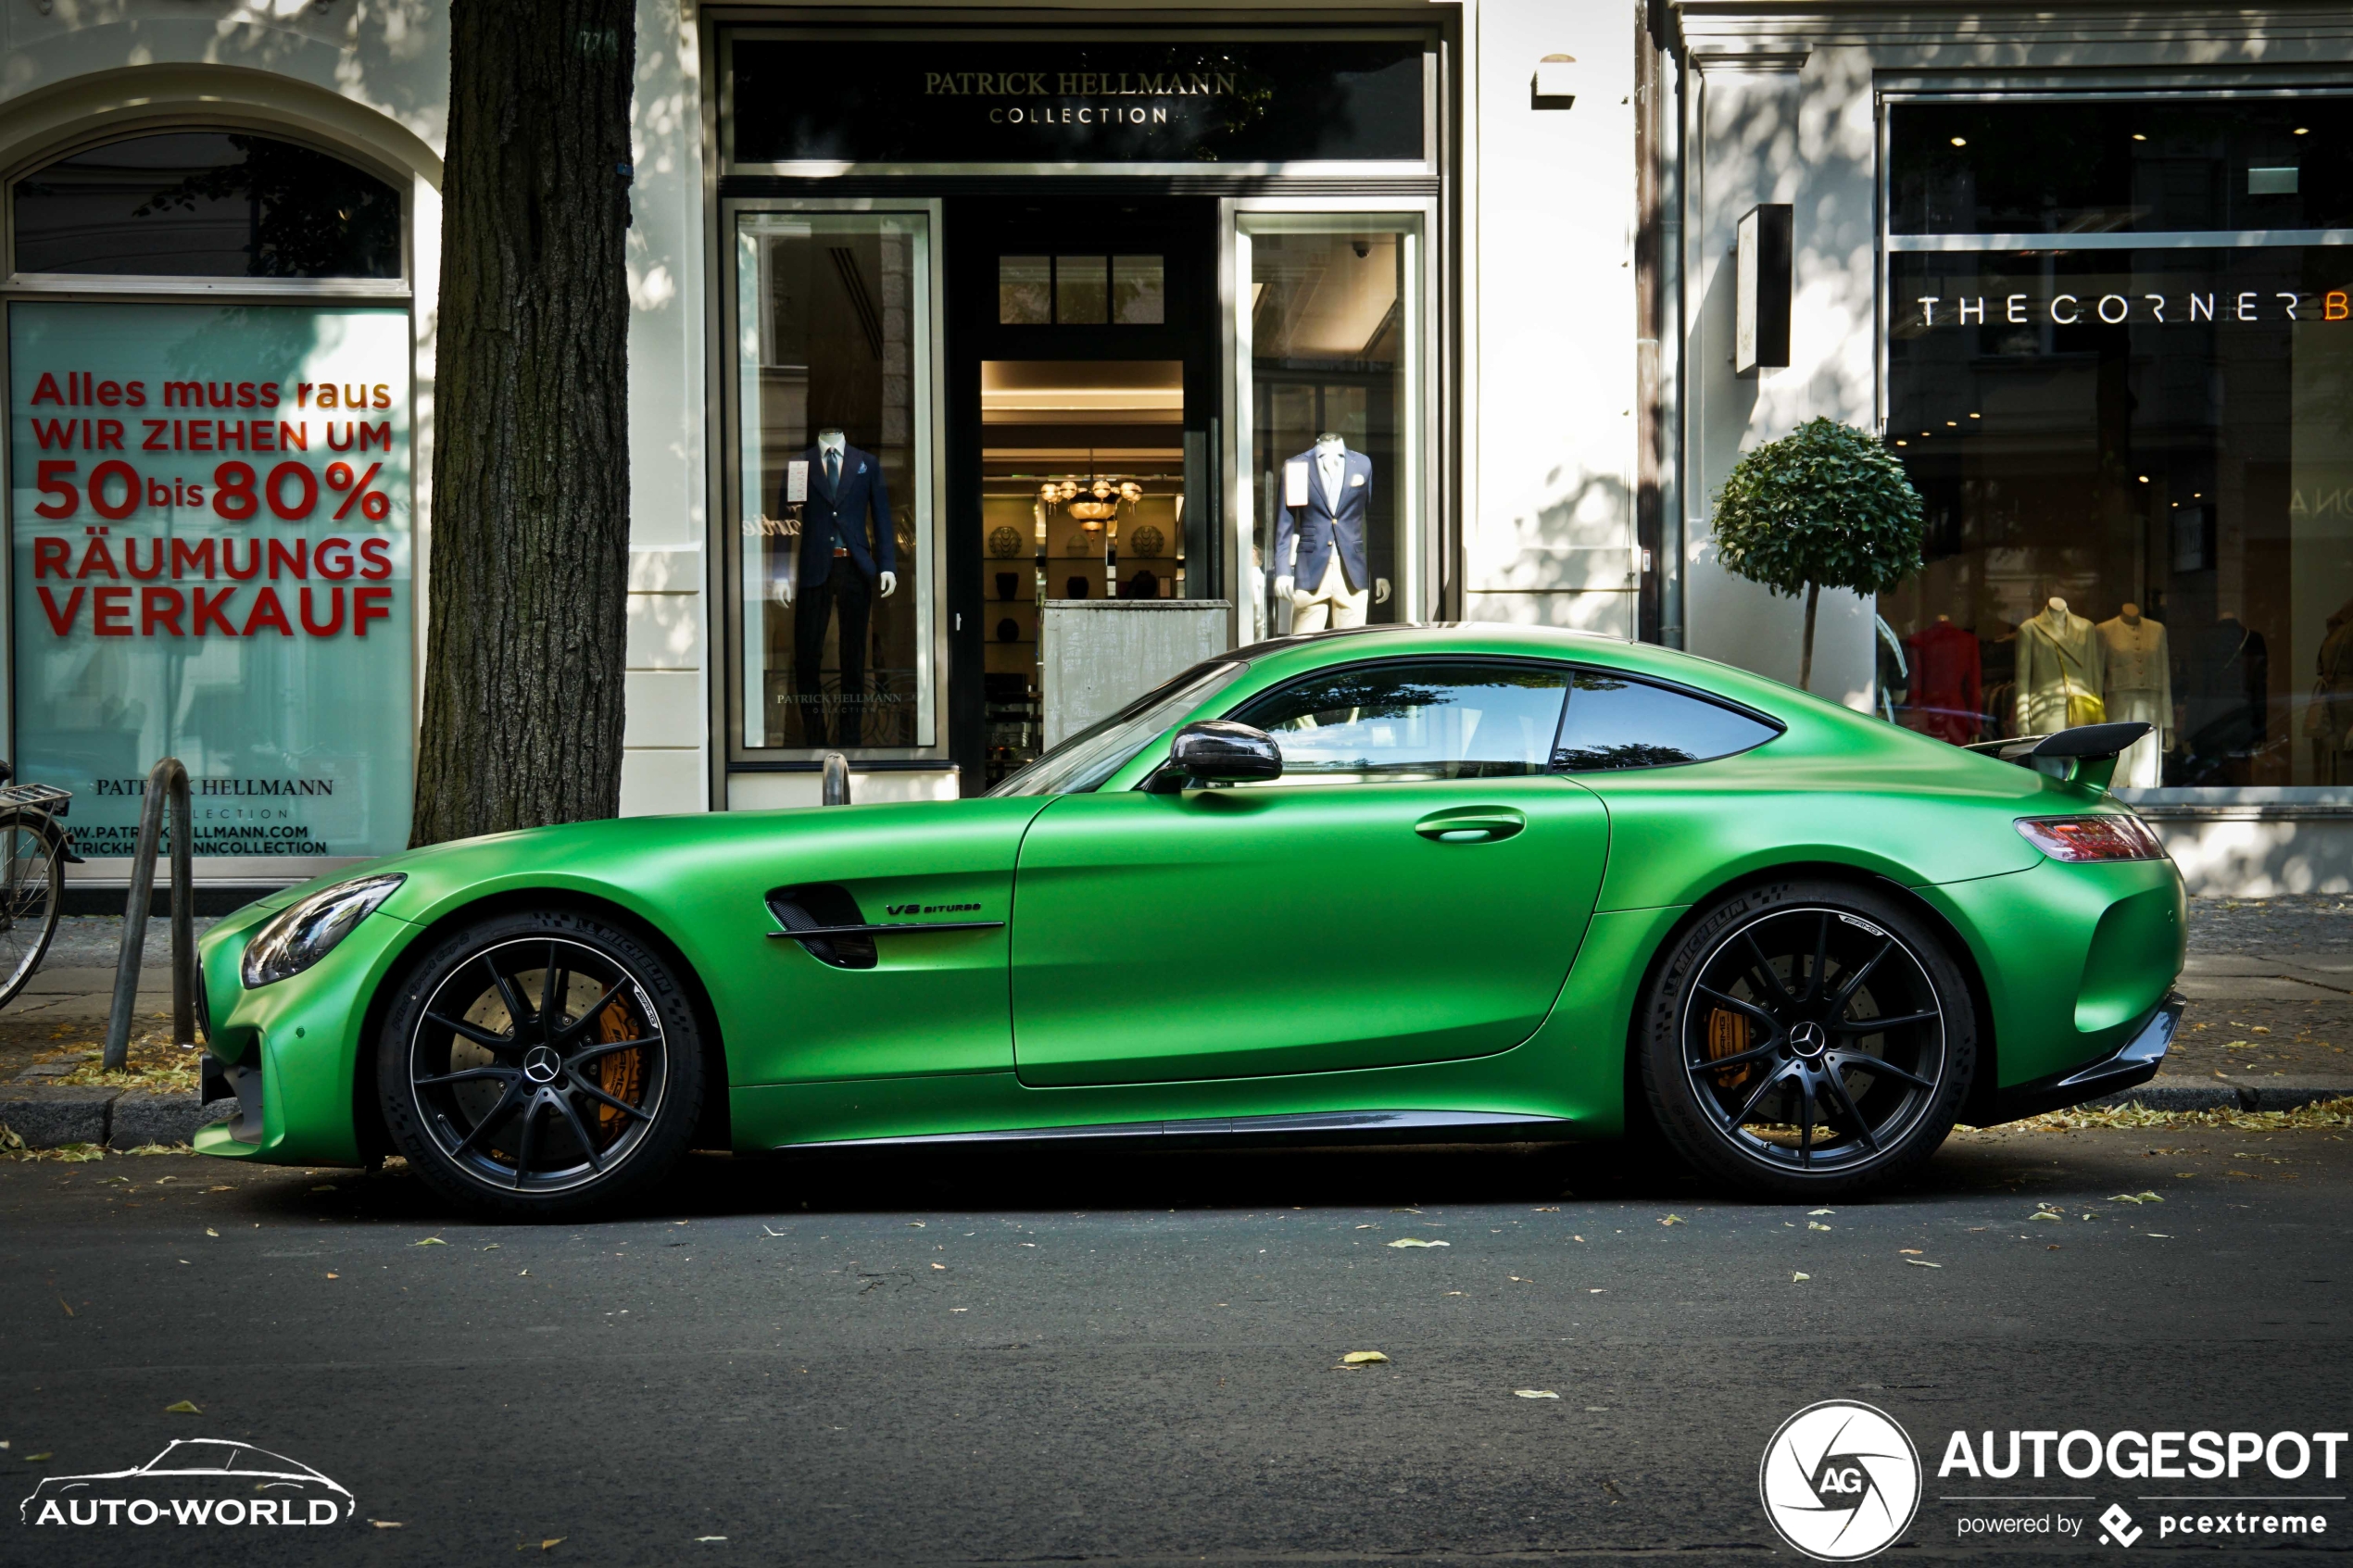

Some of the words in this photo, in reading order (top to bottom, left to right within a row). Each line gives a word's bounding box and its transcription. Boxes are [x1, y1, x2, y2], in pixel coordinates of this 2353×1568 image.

[925, 73, 1047, 94] PATRICK
[1056, 73, 1236, 94] HELLMANN
[989, 108, 1167, 124] COLLECTION
[31, 372, 145, 407] Alles
[164, 381, 280, 408] muss
[297, 383, 392, 409] raus
[31, 419, 125, 450] WIR
[142, 420, 308, 451] ZIEHEN
[327, 421, 391, 452] UM
[34, 460, 142, 520] 50
[147, 477, 204, 507] bis
[212, 461, 390, 521] 80%
[34, 527, 393, 581] RÄUMUNGS
[36, 586, 392, 636] VERKAUF
[777, 695, 830, 704] PATRICK
[834, 694, 901, 704] HELLMANN
[202, 779, 333, 796] HELLMANN
[886, 904, 921, 915] V8
[924, 902, 981, 913] BITURBO
[1673, 899, 1746, 974] MICHELIN
[408, 960, 436, 996] Sport
[435, 942, 459, 963] Cup
[598, 927, 673, 995] MICHELIN
